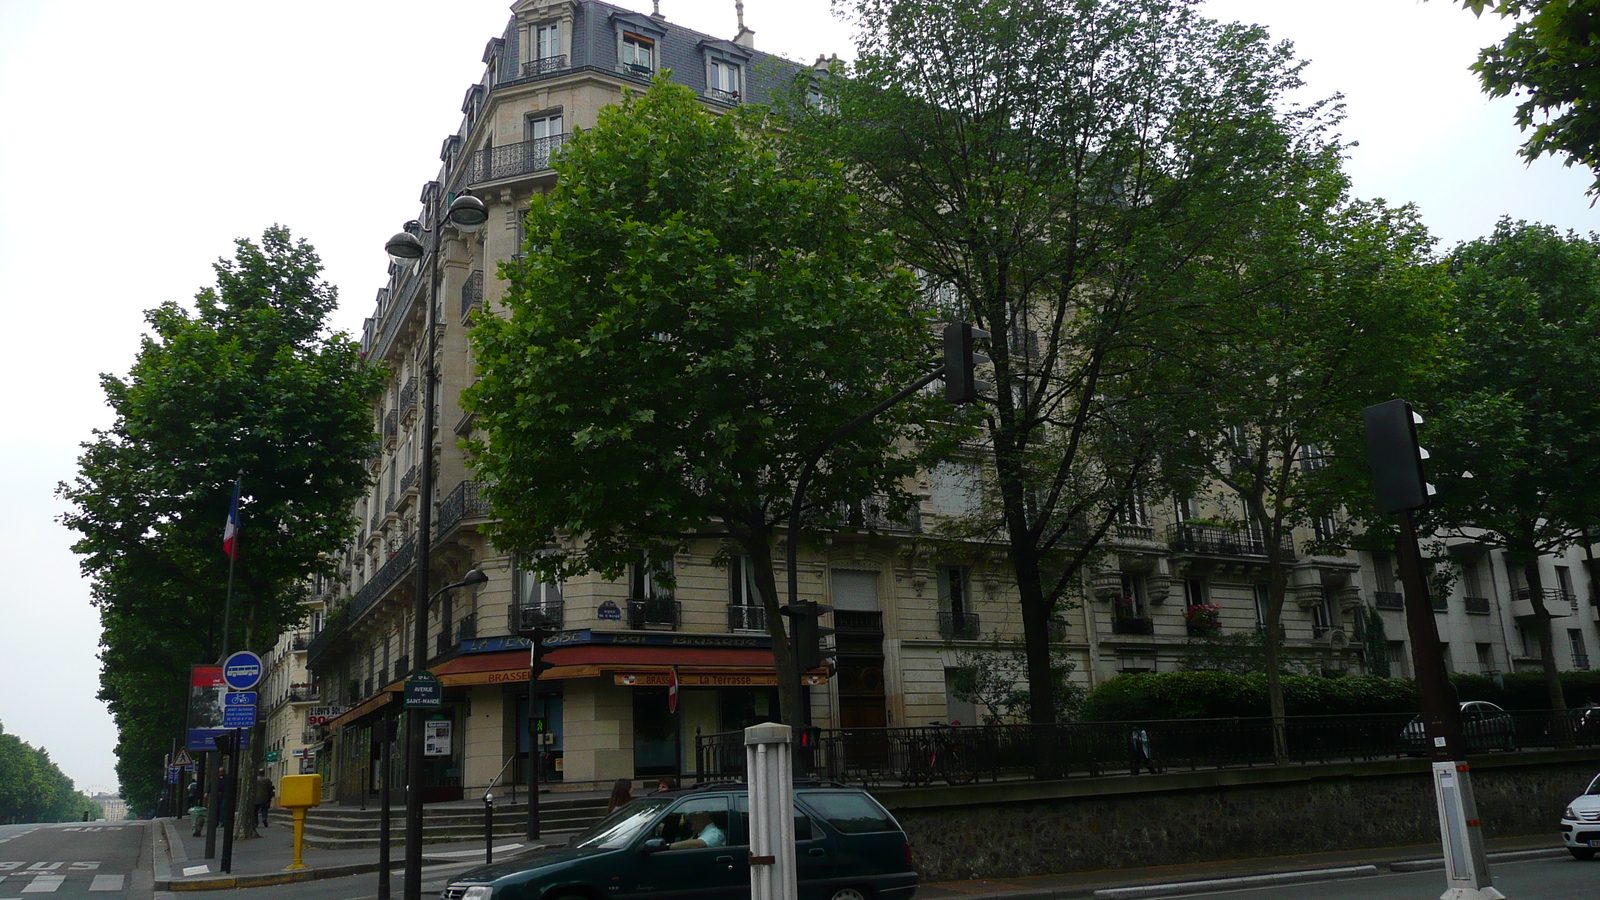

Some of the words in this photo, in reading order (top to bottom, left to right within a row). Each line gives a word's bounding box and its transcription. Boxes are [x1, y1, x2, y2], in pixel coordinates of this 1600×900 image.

[470, 638, 489, 650] LA
[612, 635, 649, 643] Bar
[672, 636, 757, 646] Brasserie
[488, 671, 531, 683] BRASSE
[699, 676, 709, 684] La
[712, 676, 752, 685] Terrasse
